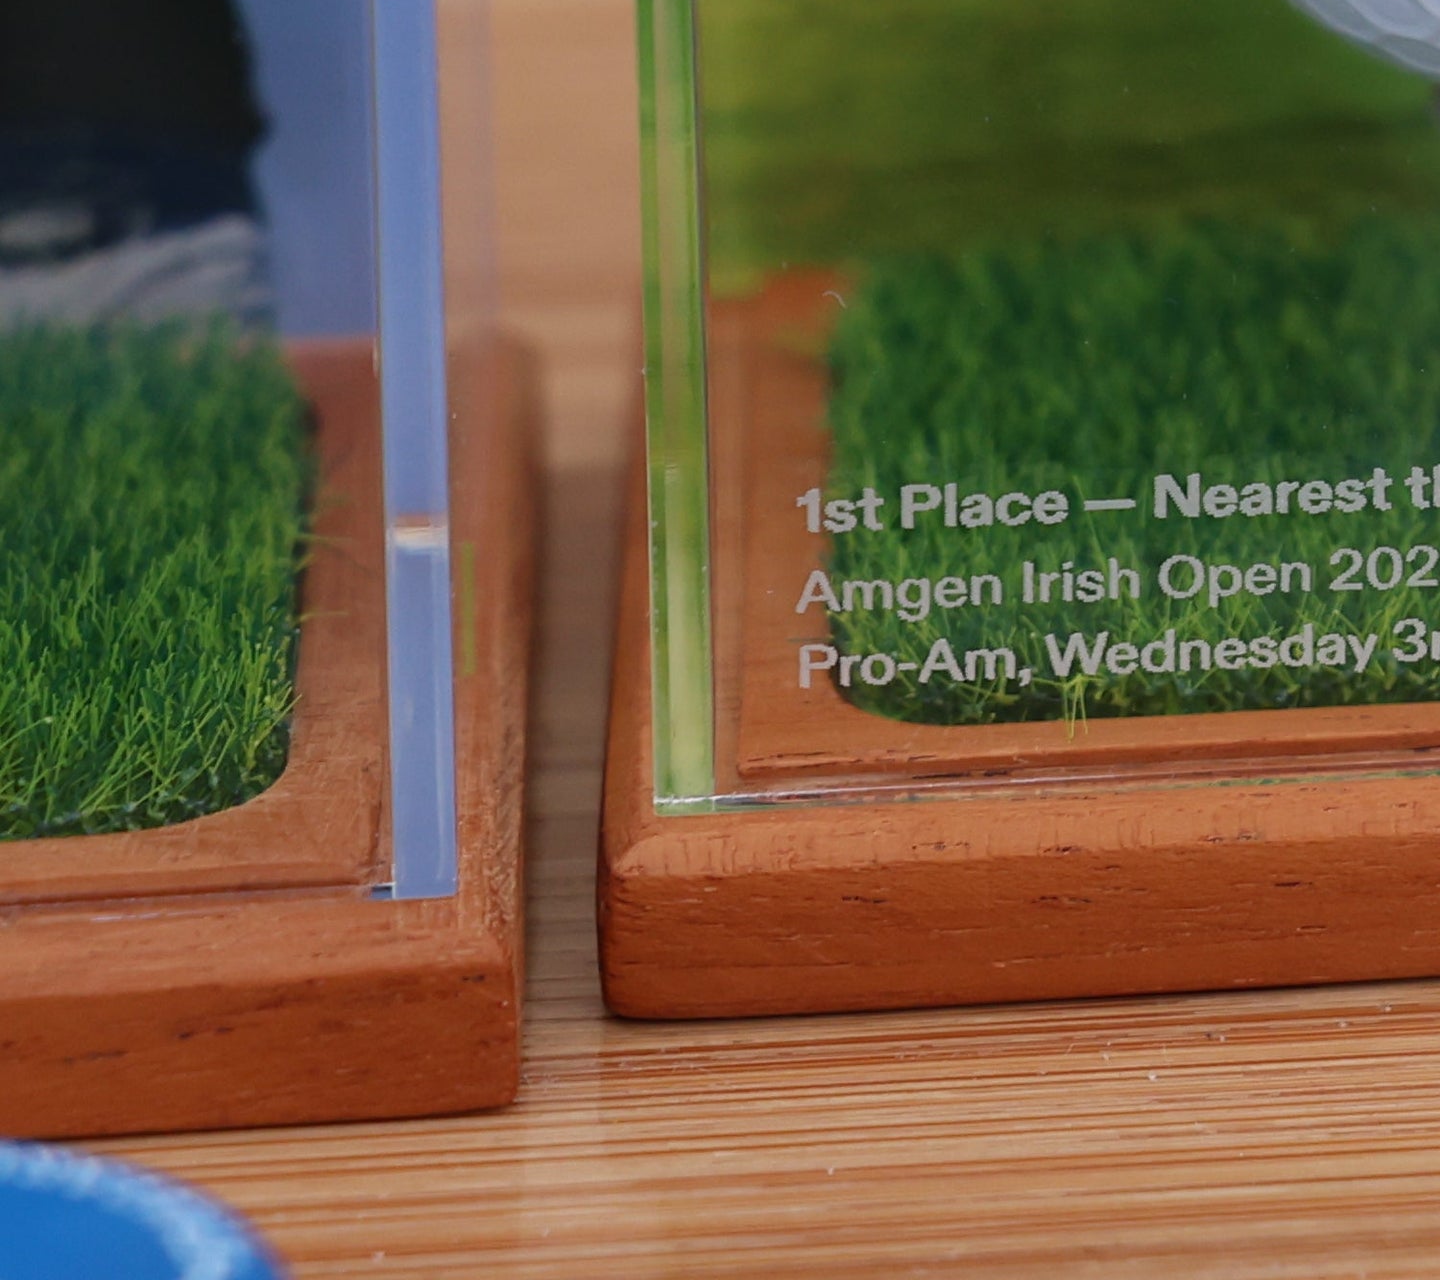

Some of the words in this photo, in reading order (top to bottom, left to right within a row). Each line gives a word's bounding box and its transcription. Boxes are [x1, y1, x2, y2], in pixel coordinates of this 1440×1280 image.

[797, 487, 885, 534] 1st
[900, 482, 1069, 529] Place
[1153, 467, 1393, 519] Nearest
[795, 570, 1002, 623] Amgen
[1022, 558, 1141, 604] Irish
[1158, 554, 1312, 608] Open
[799, 638, 1032, 689] Pro-Am,
[1044, 622, 1377, 677] Wednesday
